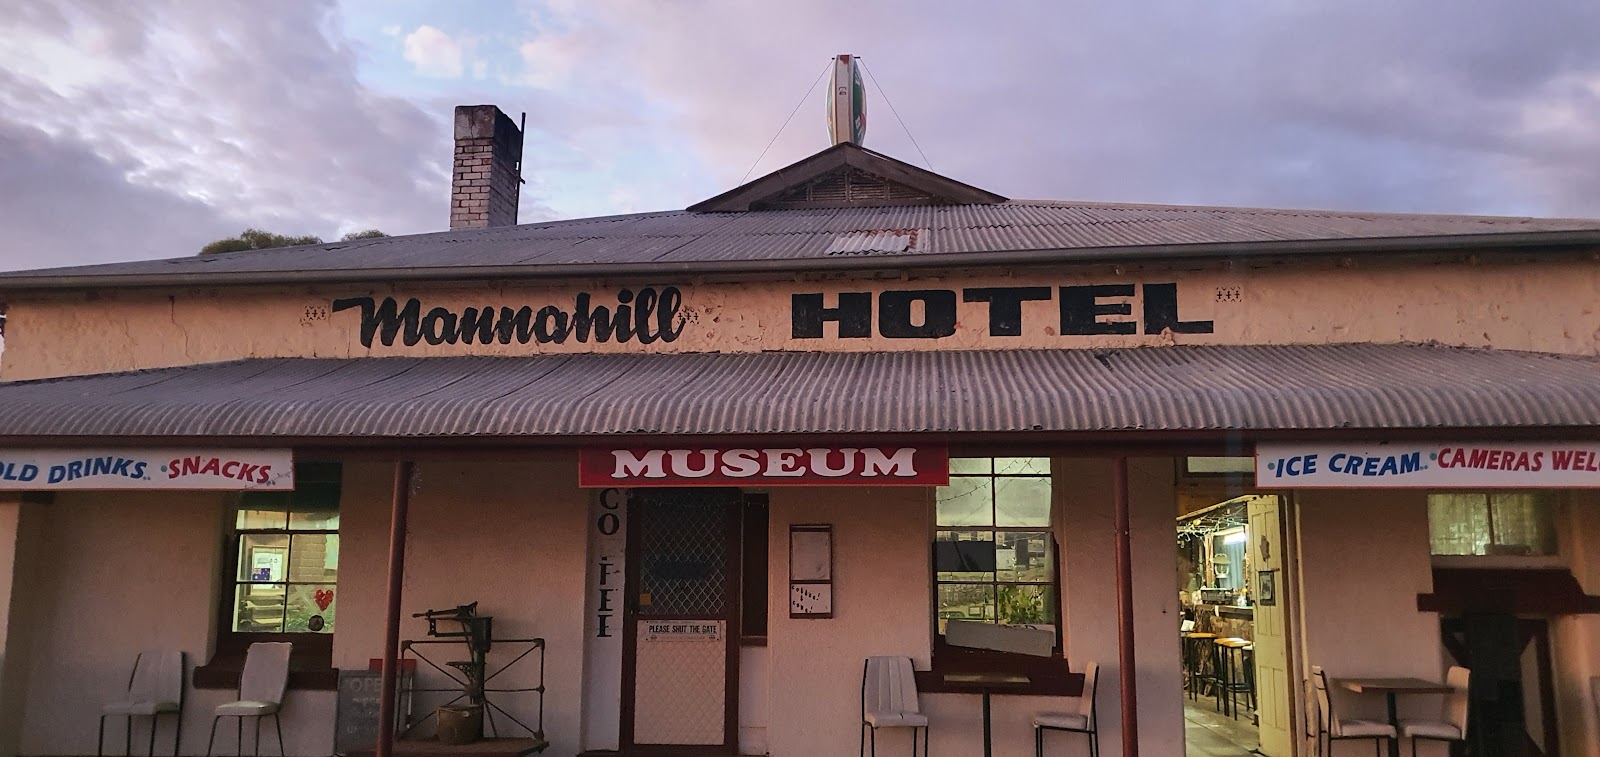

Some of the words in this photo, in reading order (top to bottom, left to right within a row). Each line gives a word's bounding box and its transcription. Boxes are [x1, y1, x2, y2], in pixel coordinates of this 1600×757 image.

[332, 286, 687, 348] Mannahill
[791, 282, 1215, 339] HOTEL
[0, 461, 39, 482] LD
[610, 447, 918, 479] MUSEUM
[1276, 454, 1318, 477] ICE
[1438, 448, 1544, 472] CAMERAS
[1552, 450, 1600, 472] WEL
[649, 625, 670, 633] PLEASE
[672, 625, 687, 633] SHUT
[690, 625, 701, 633] THE
[702, 625, 717, 633] GATE
